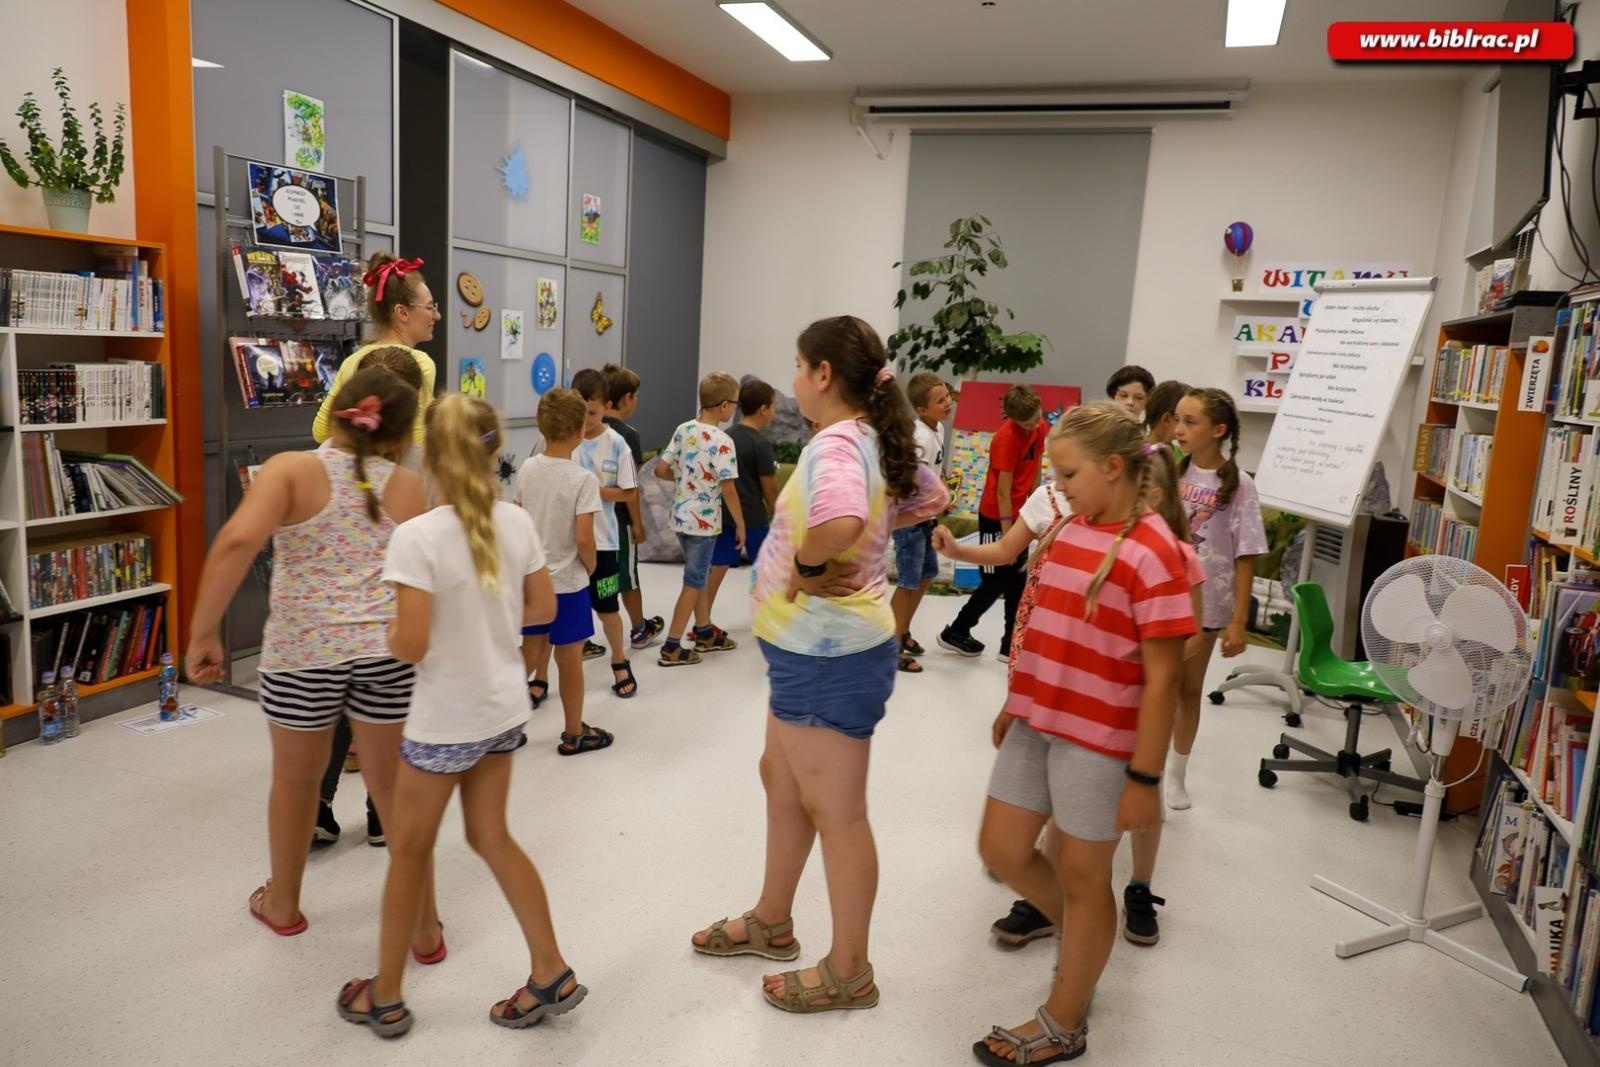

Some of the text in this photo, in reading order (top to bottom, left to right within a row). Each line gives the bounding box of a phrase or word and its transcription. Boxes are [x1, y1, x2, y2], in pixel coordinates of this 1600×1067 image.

[1270, 351, 1294, 371] P
[1243, 379, 1288, 398] KL
[1525, 358, 1541, 409] ZWIERZĘTA
[1563, 467, 1582, 523] ROŚLINY
[597, 573, 619, 591] NEW
[597, 584, 619, 600] YORK
[1549, 919, 1564, 975] NAUKA
